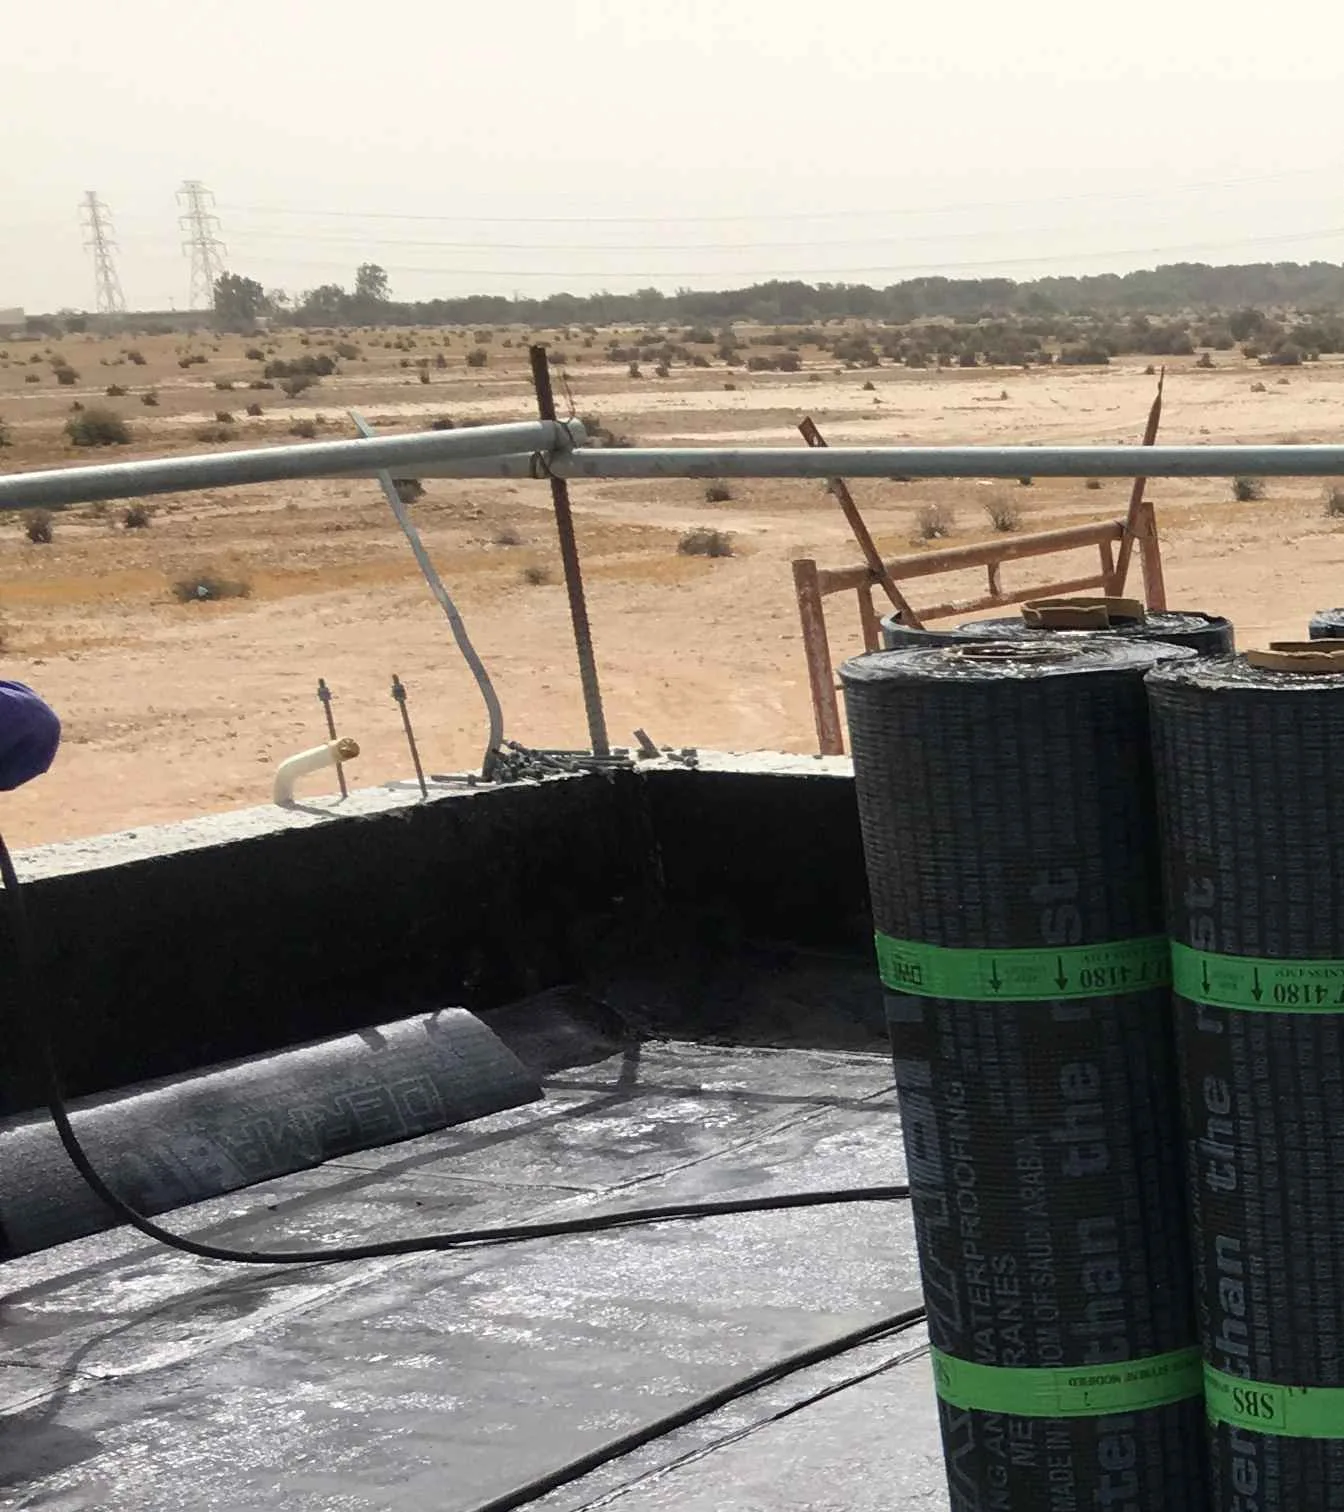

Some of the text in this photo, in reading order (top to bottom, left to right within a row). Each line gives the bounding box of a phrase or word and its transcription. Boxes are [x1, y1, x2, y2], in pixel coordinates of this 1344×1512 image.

[1029, 865, 1090, 1021] rst
[1183, 872, 1223, 1033] rst
[1271, 981, 1328, 1004] 4180
[1050, 1060, 1112, 1176] the
[1197, 1071, 1239, 1193] the
[1014, 1131, 1050, 1216] ARABIA
[1032, 1291, 1057, 1322] OF
[1209, 1232, 1252, 1381] than
[990, 1253, 1038, 1465] MERANES
[1231, 1386, 1273, 1419] SBS
[1044, 1428, 1070, 1450] IN
[1046, 1455, 1077, 1512] MADE
